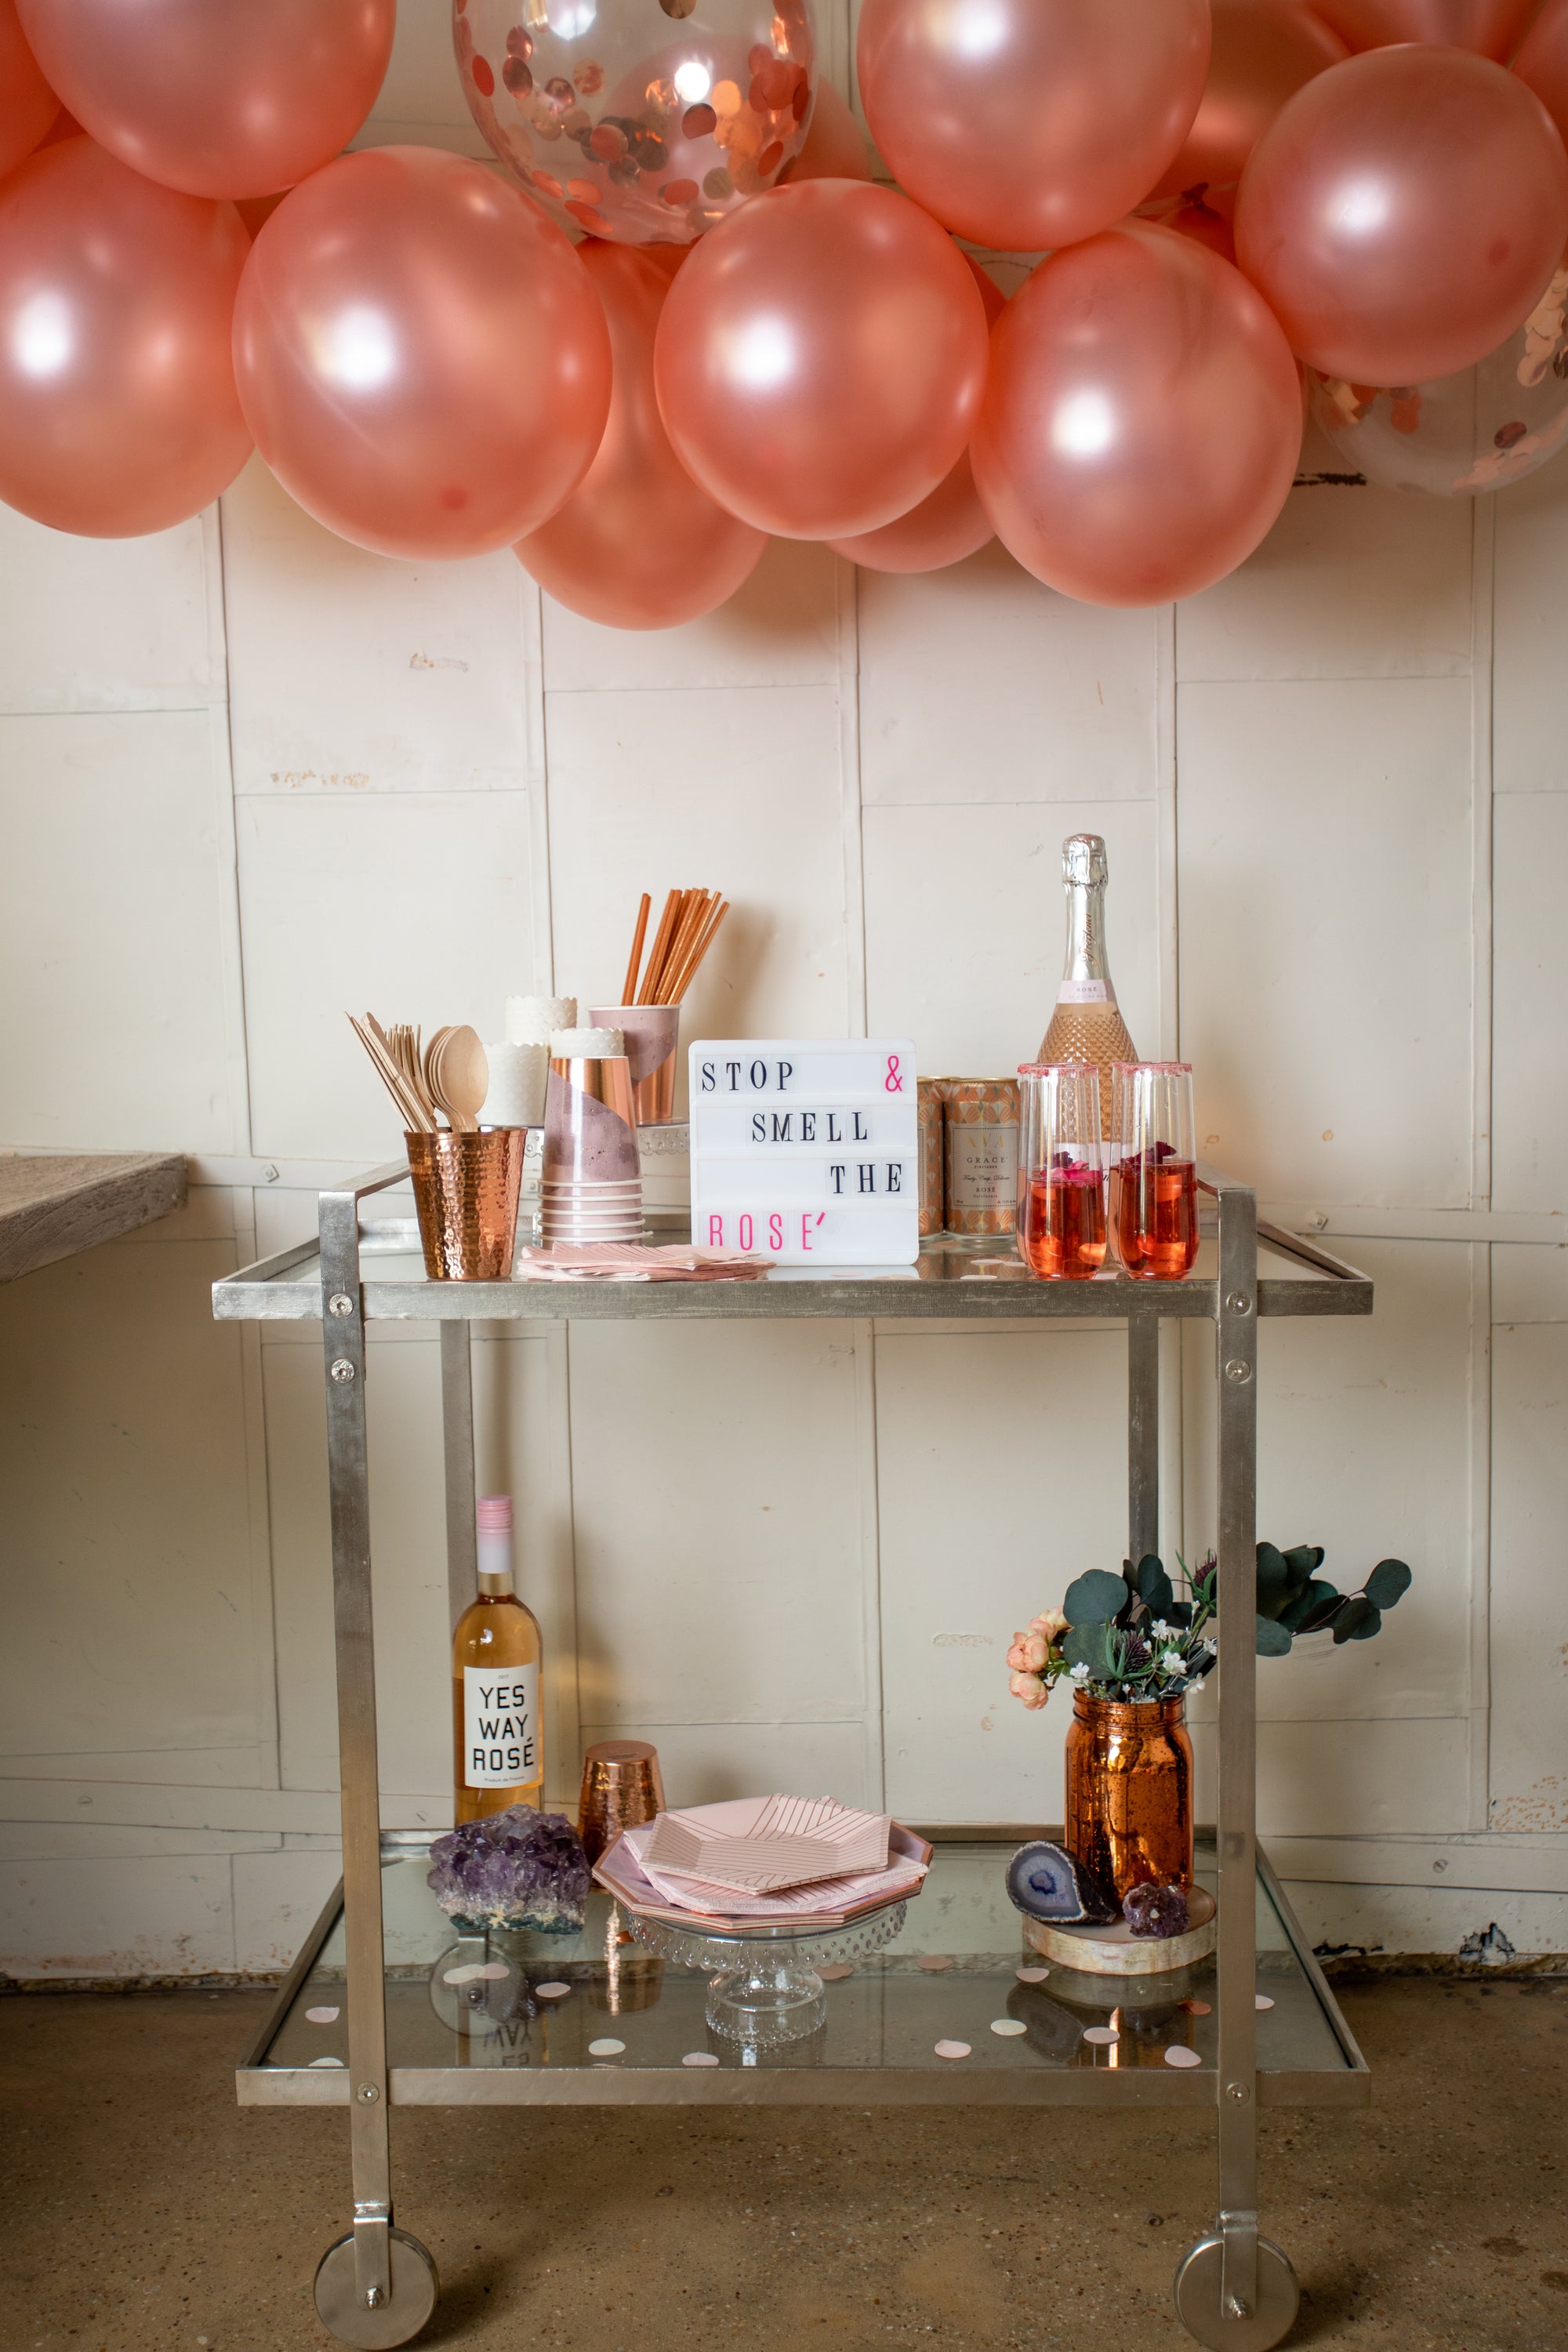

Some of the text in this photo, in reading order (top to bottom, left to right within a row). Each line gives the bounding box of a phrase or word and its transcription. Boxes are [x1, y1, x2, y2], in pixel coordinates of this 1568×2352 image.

[702, 1054, 903, 1092] STOP &
[751, 1112, 868, 1142] SMELL
[829, 1163, 902, 1194] THE
[479, 1685, 524, 1709] YES
[478, 1714, 528, 1740] WAY
[473, 1737, 534, 1771] ROSÉ
